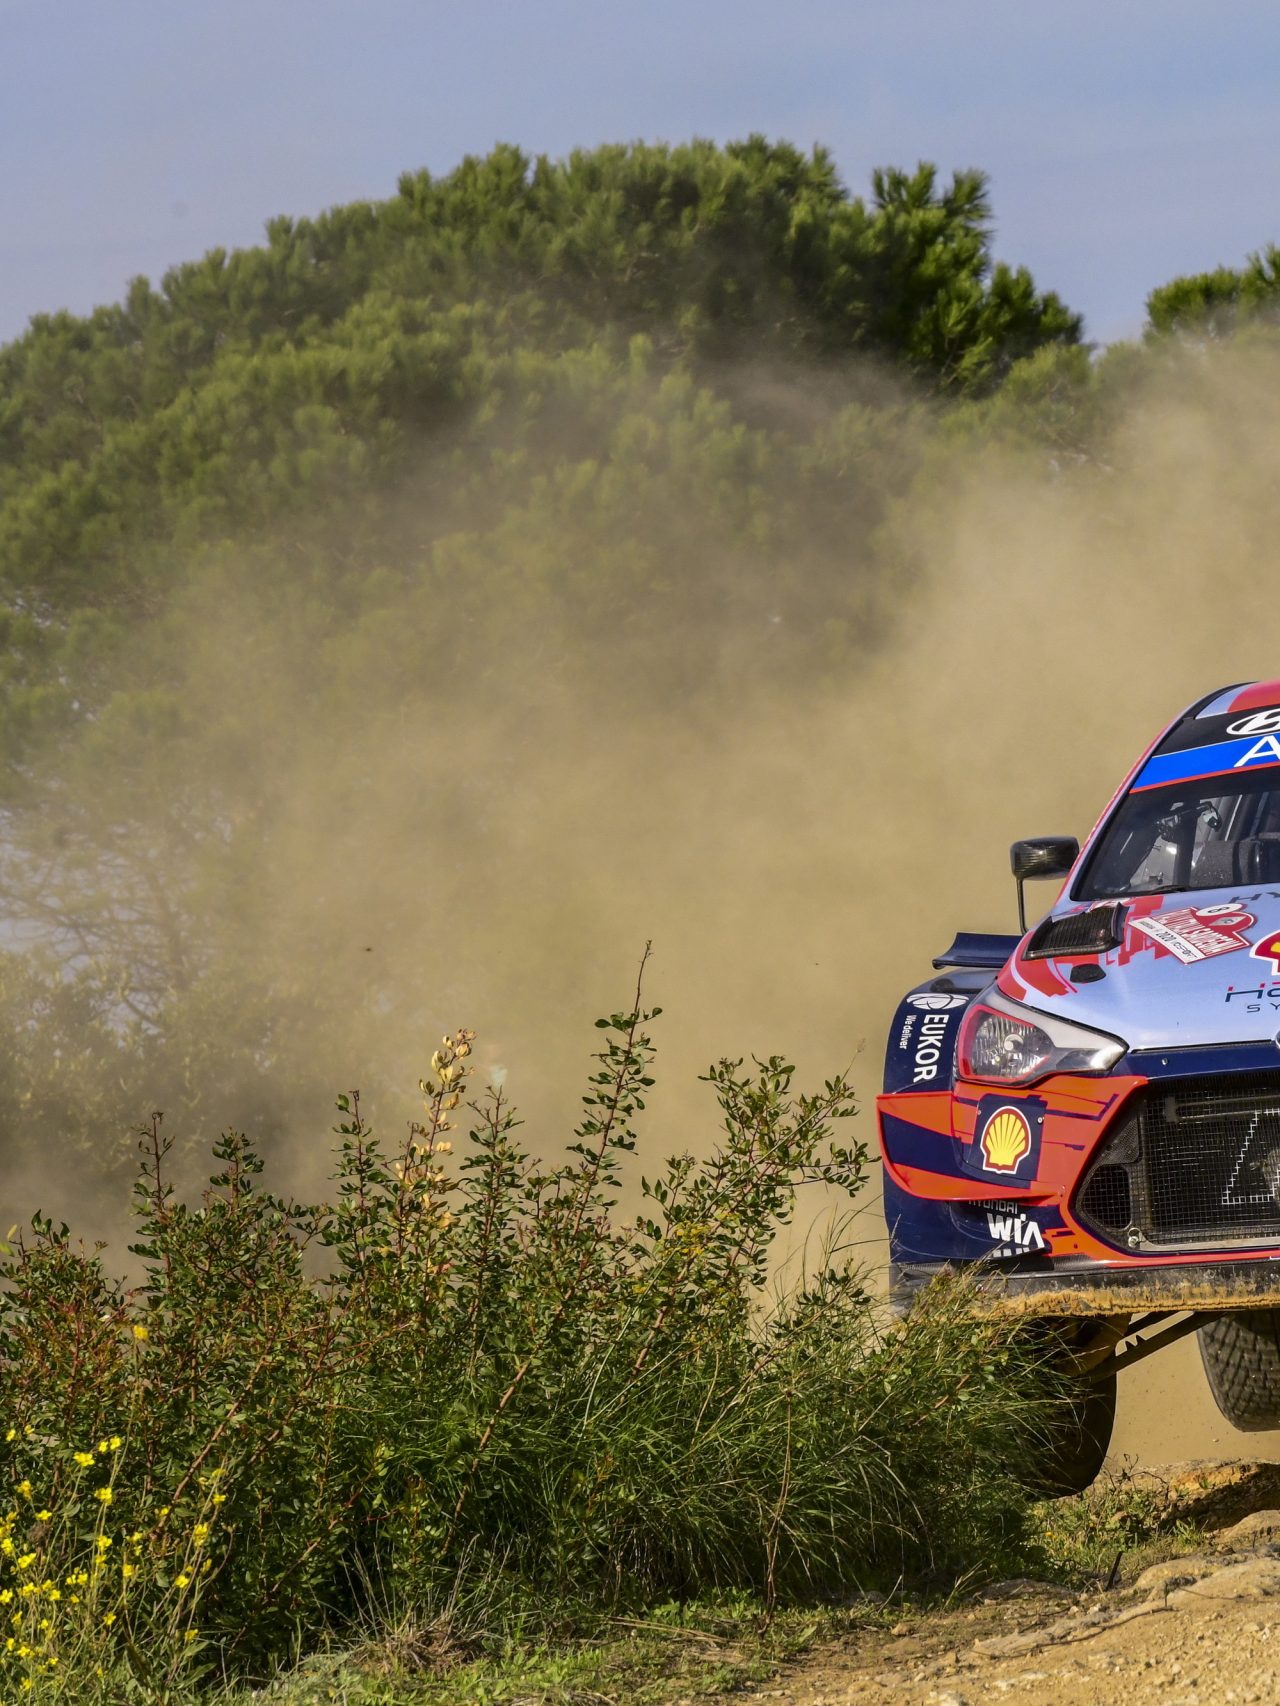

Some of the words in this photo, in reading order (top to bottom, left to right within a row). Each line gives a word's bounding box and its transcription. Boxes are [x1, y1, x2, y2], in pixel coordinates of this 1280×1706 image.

[904, 1014, 917, 1025] We
[899, 1025, 913, 1050] deliver
[913, 1014, 949, 1083] EUKOR
